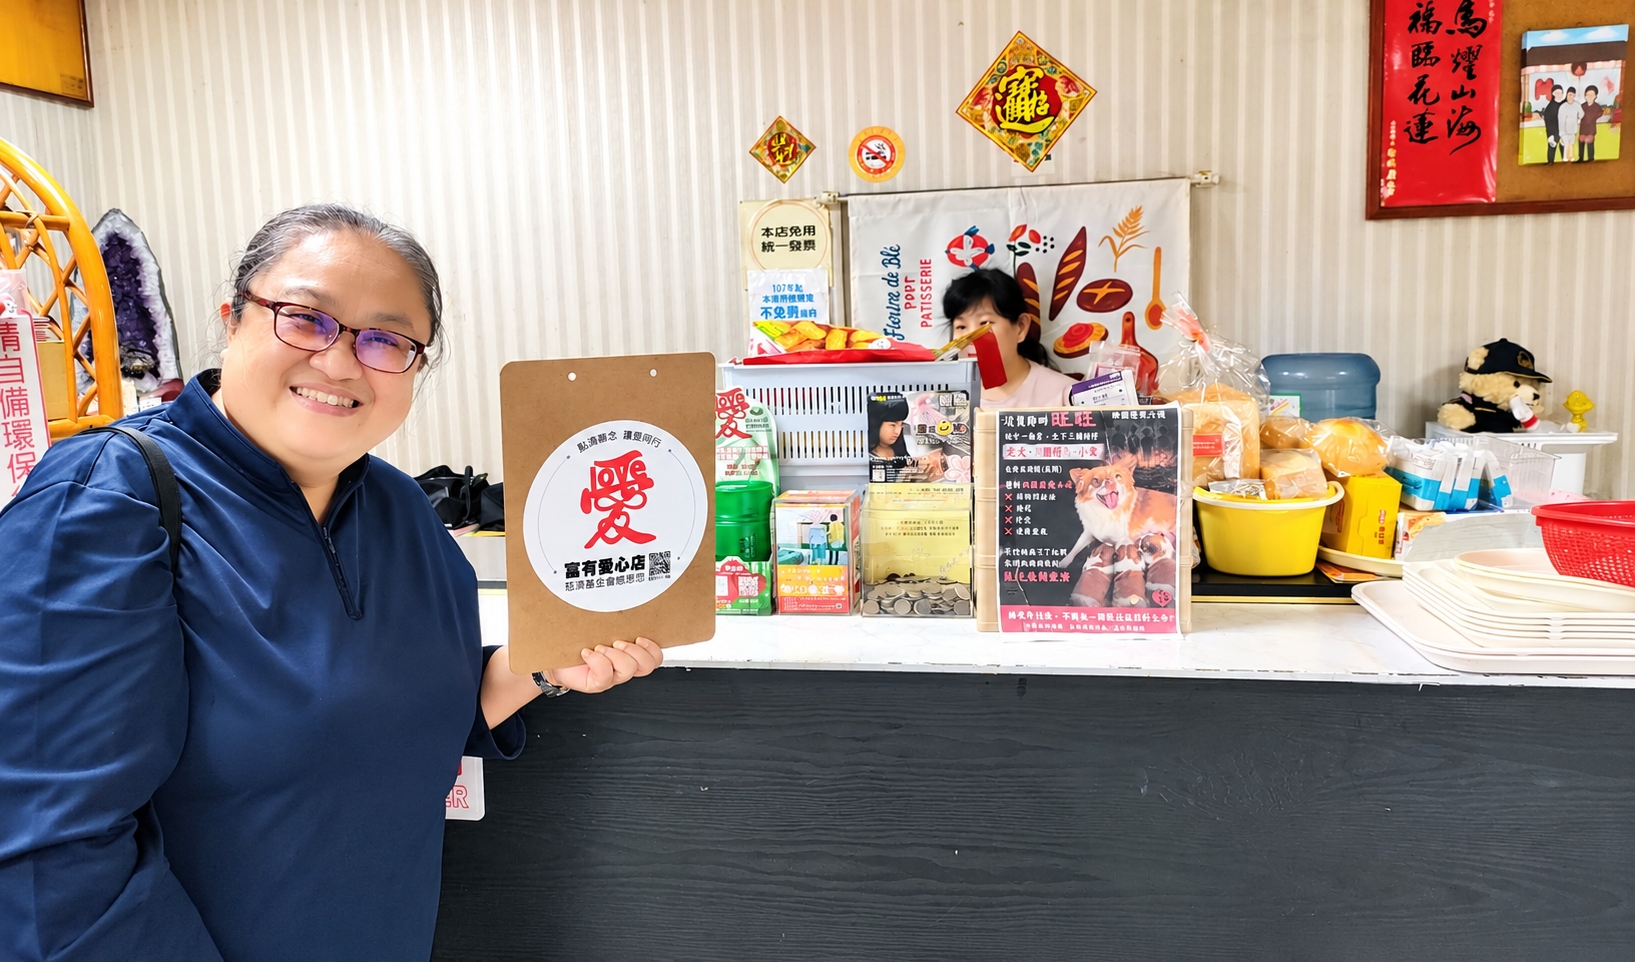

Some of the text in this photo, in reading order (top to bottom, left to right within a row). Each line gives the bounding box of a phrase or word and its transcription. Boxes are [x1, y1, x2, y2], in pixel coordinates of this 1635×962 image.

[761, 225, 816, 238] 本店免用
[879, 243, 902, 270] Blé
[881, 271, 900, 288] de
[919, 258, 933, 328] PATISSERIE
[0, 321, 36, 498] 請自備環保
[564, 554, 646, 579] 富有愛心店
